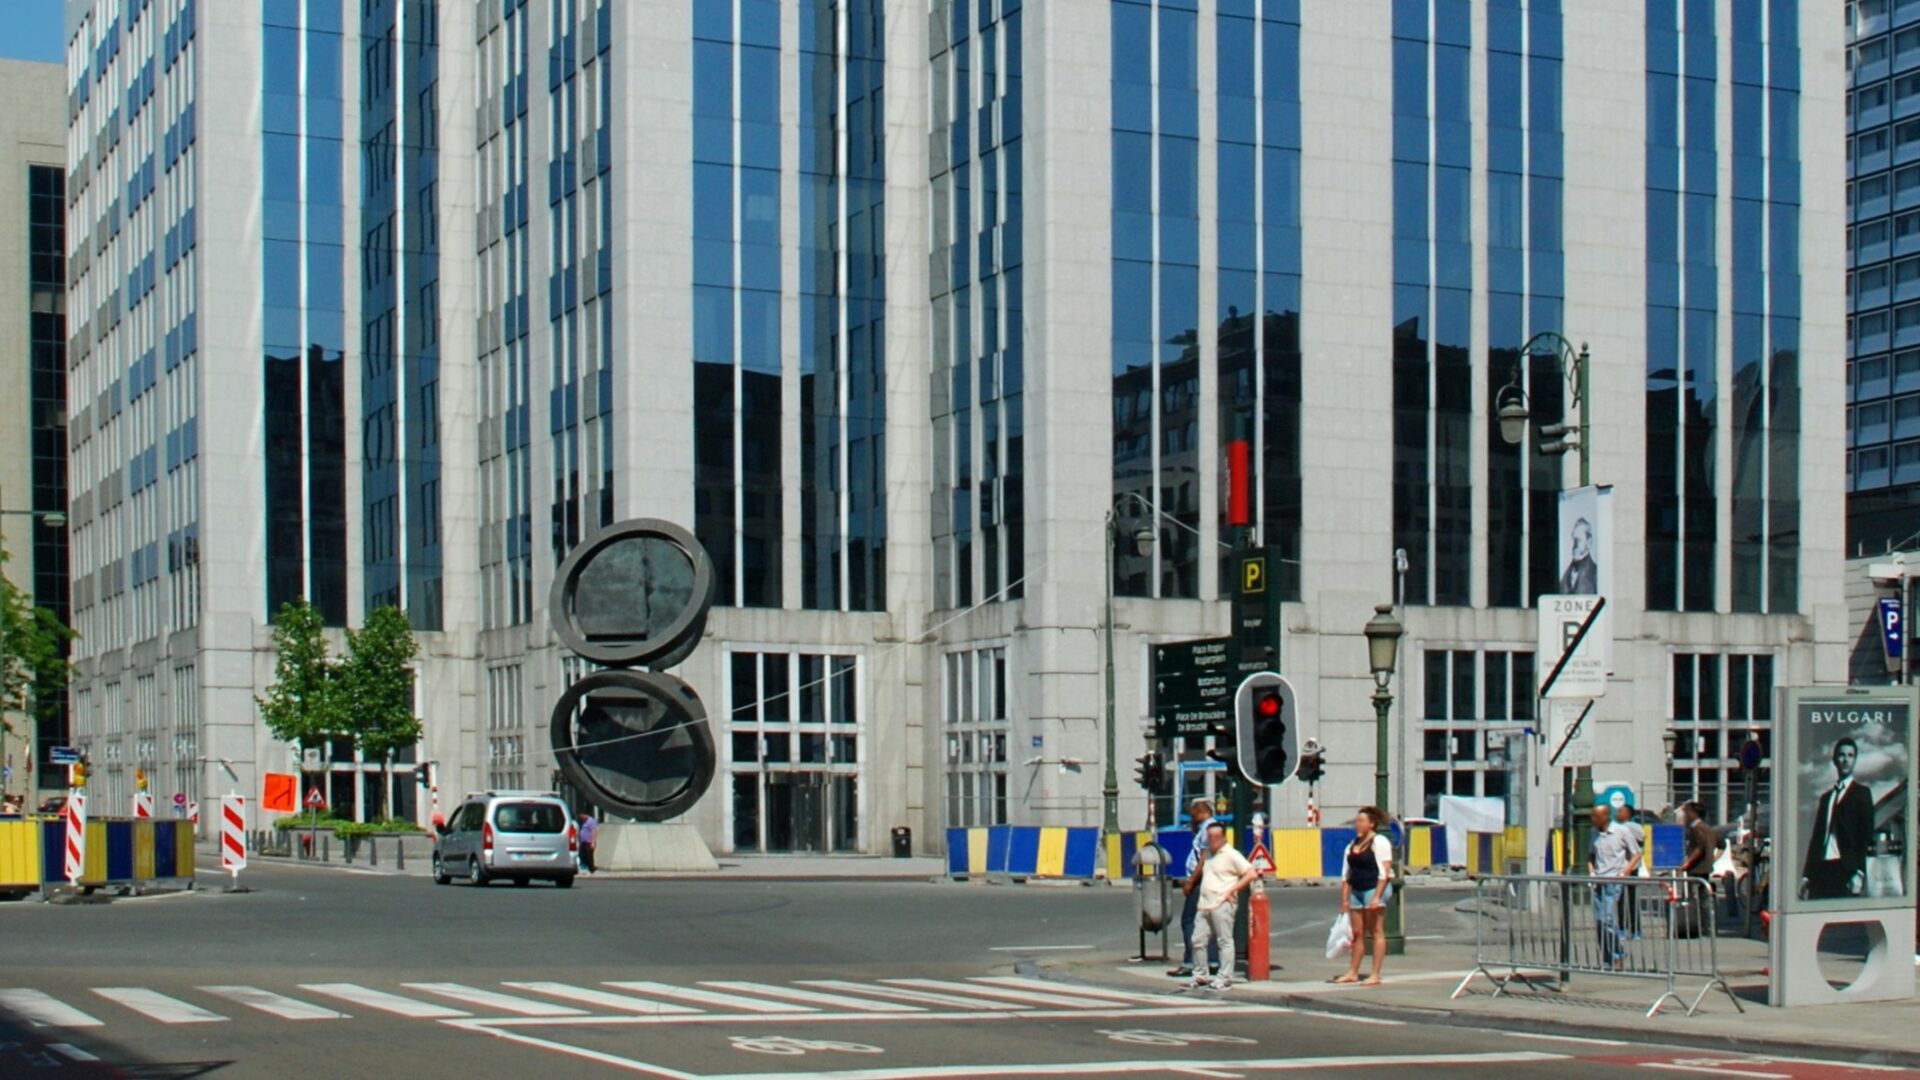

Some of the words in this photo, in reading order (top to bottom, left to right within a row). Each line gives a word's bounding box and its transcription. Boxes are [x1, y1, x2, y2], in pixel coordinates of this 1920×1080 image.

[1247, 562, 1260, 588] P
[1554, 600, 1592, 612] ZONE
[1887, 611, 1899, 630] P
[1190, 711, 1198, 721] De
[1811, 711, 1892, 723] BVLGARI
[1177, 722, 1185, 733] De
